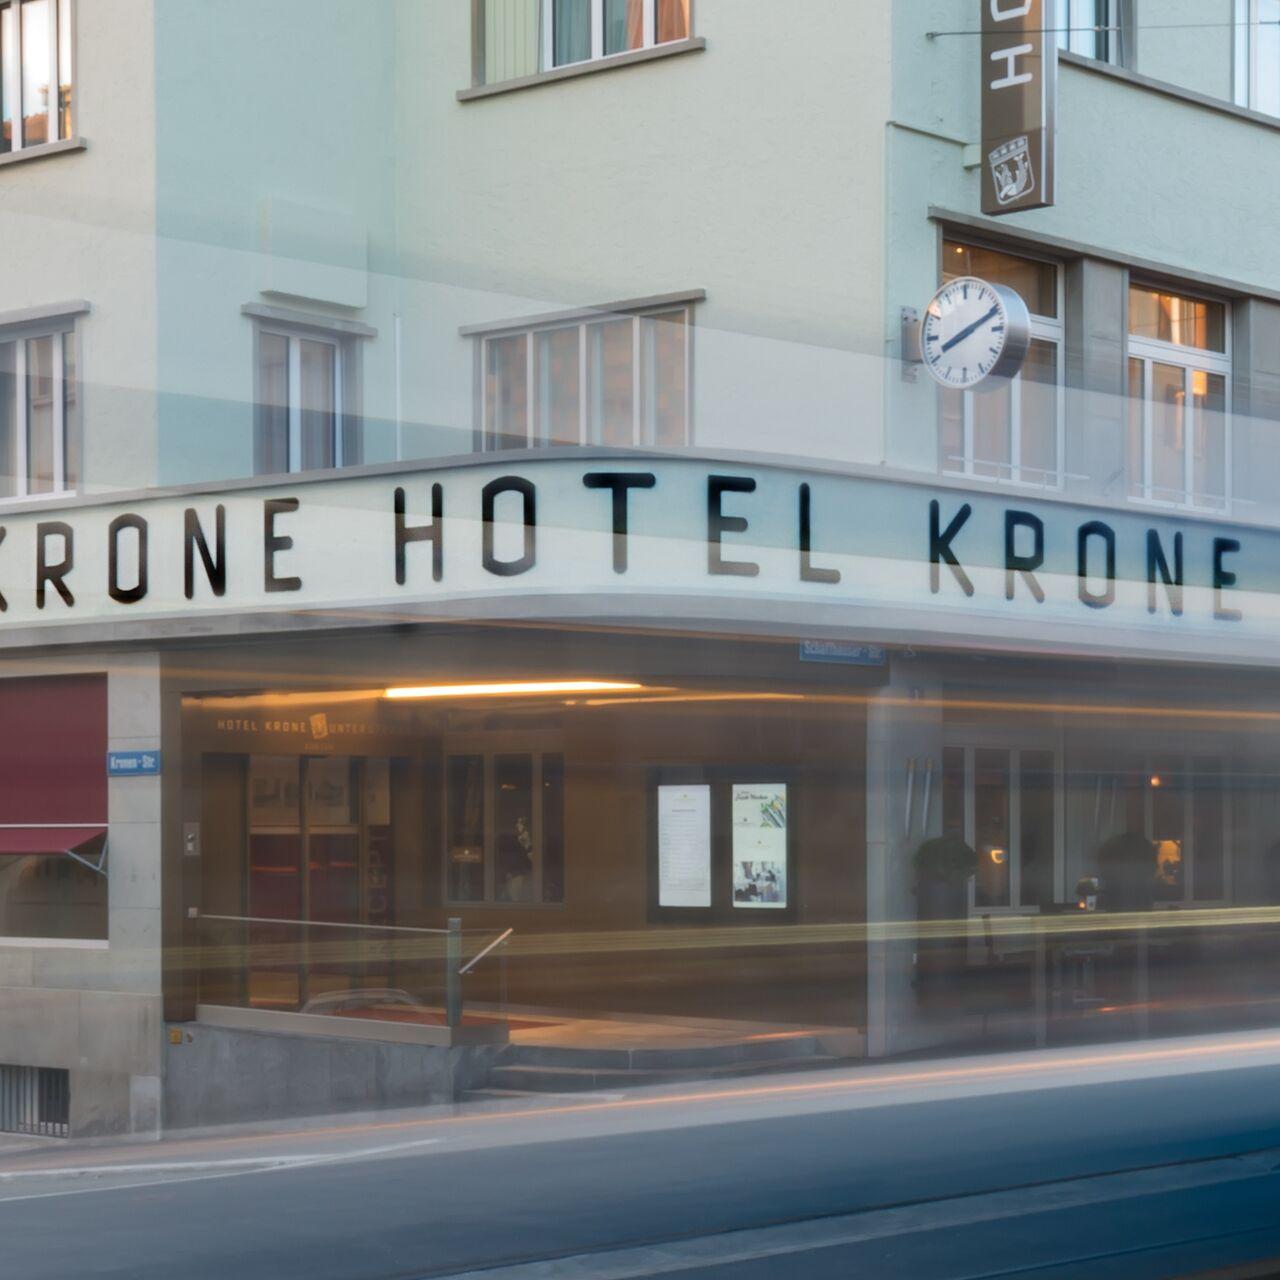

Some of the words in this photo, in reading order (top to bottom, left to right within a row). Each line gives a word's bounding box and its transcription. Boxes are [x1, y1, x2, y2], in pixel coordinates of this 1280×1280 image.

[393, 471, 841, 586] HOTEL
[928, 498, 1244, 622] KRONE
[217, 719, 258, 733] HOTEL
[264, 720, 308, 734] KRONE
